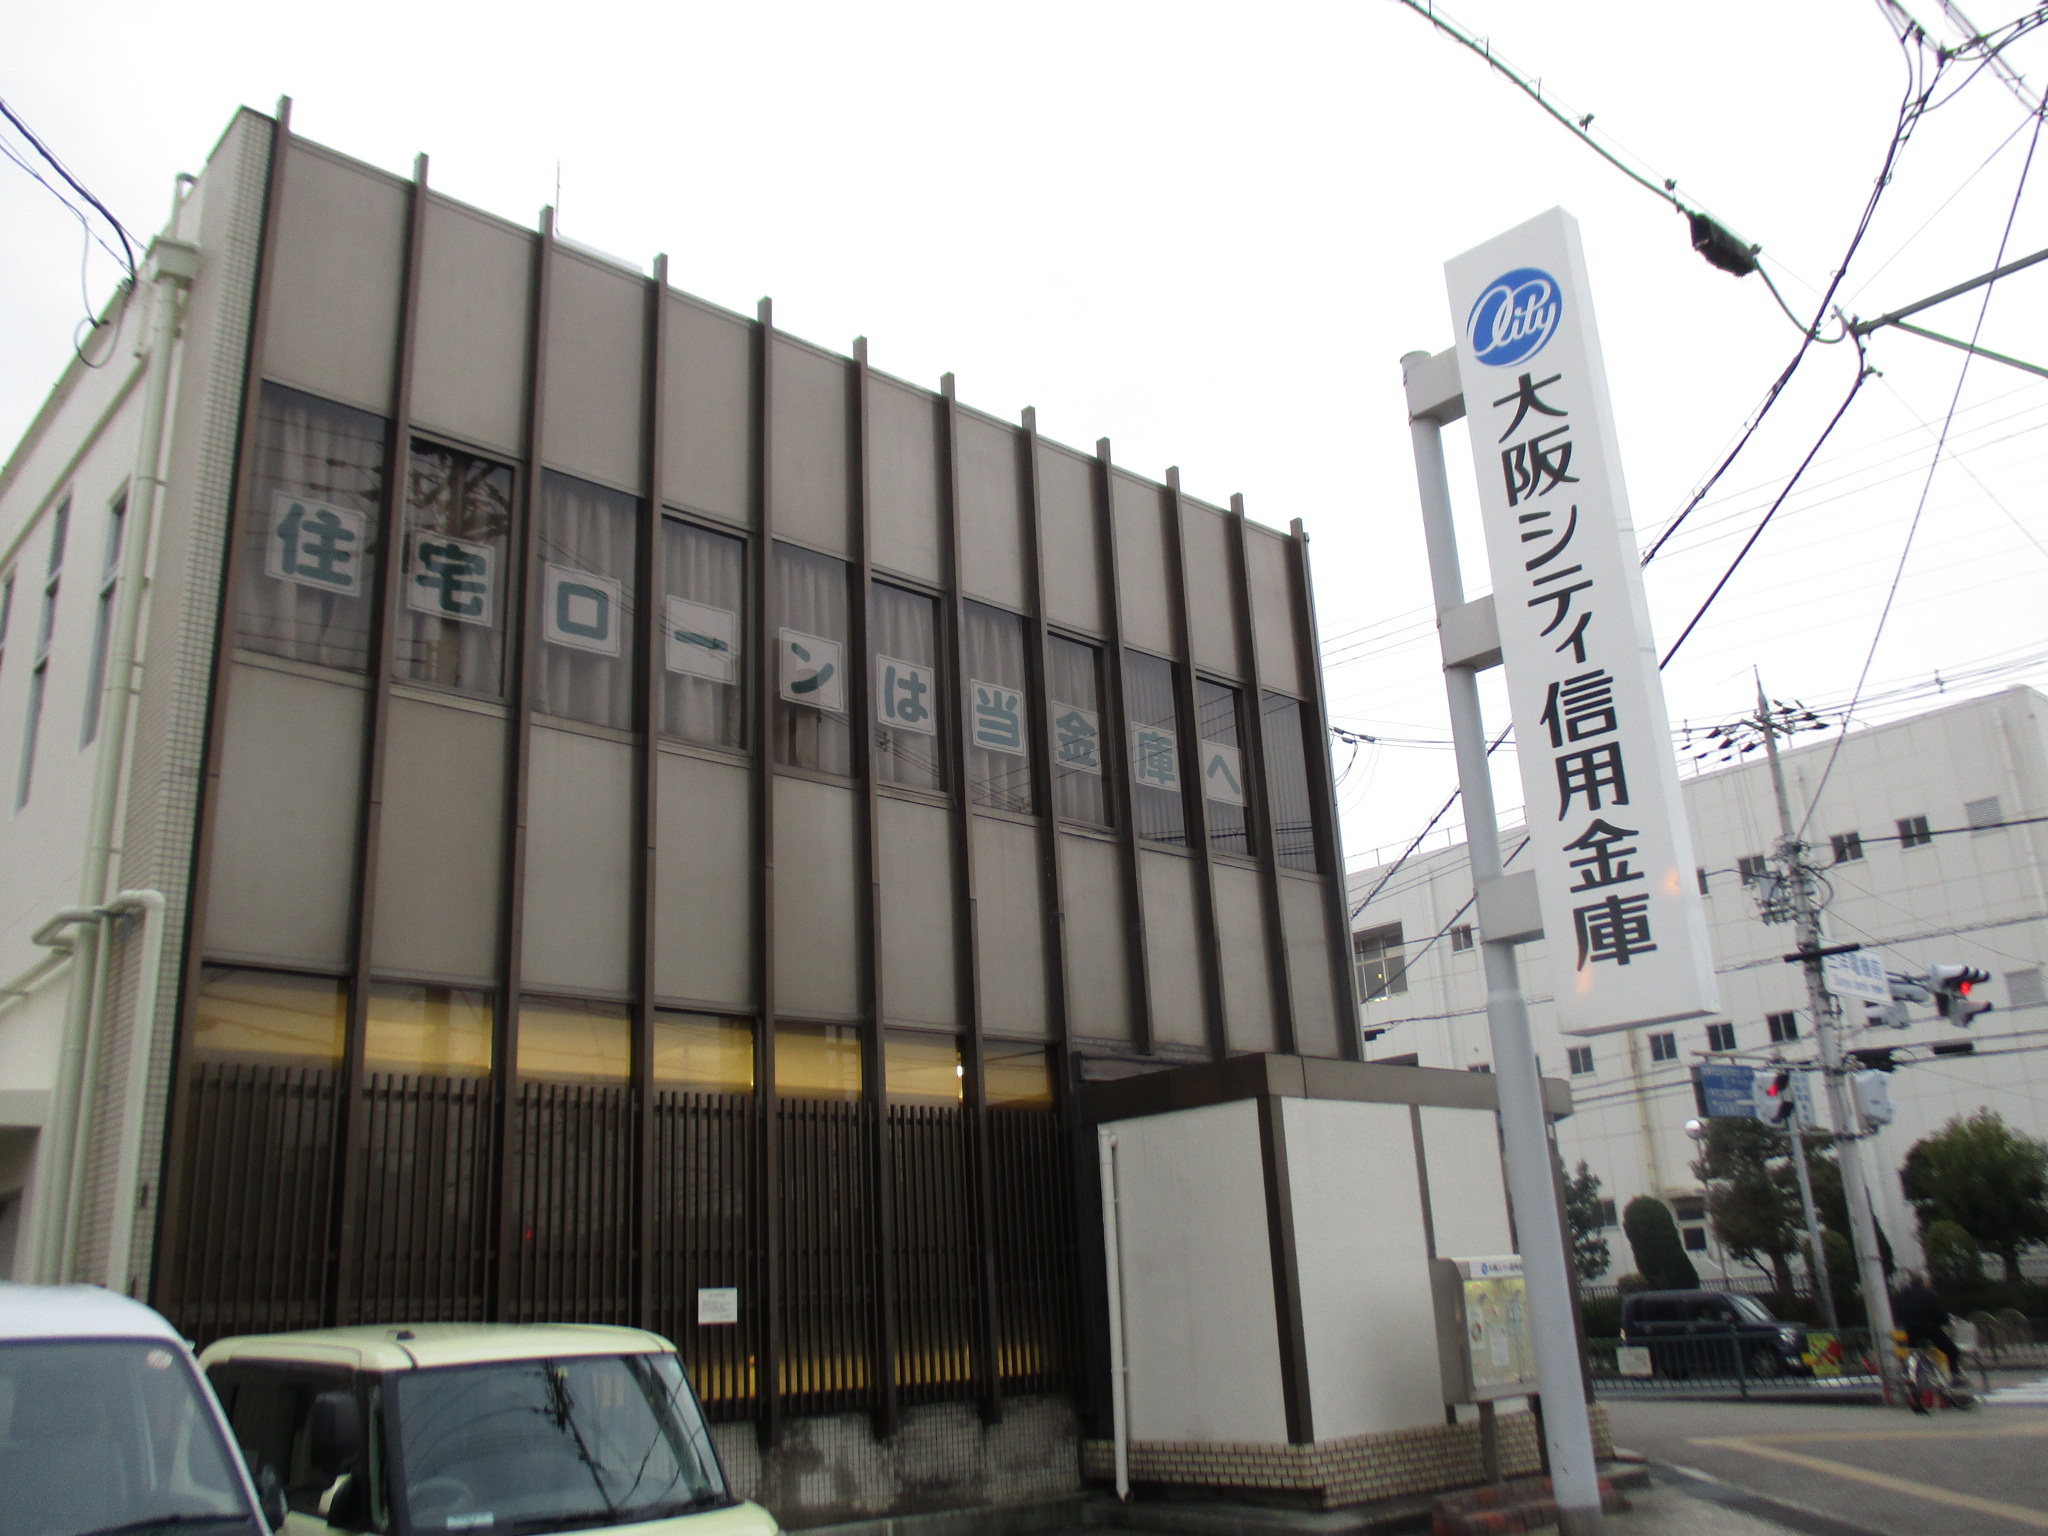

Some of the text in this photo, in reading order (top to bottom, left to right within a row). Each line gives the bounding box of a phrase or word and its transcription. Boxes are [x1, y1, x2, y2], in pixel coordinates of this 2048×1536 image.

[1493, 371, 1658, 972] 大阪シティ信用金庫
